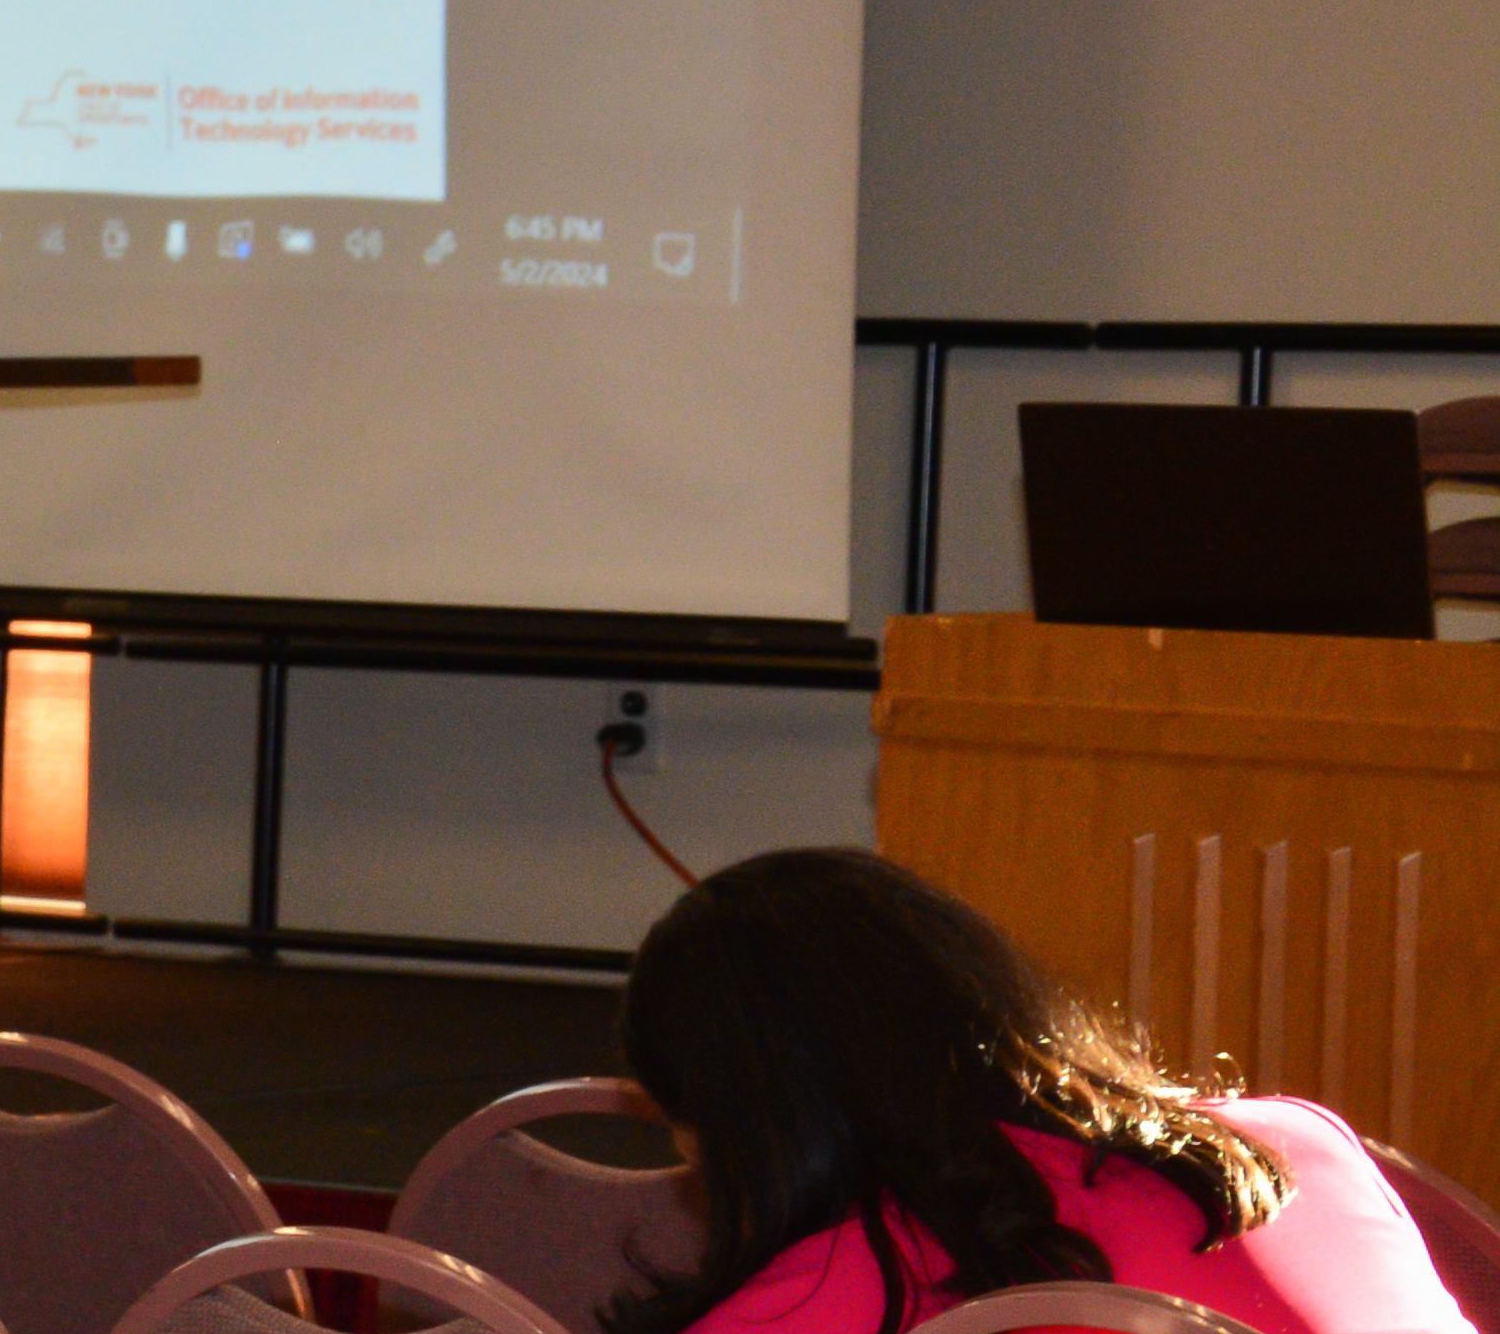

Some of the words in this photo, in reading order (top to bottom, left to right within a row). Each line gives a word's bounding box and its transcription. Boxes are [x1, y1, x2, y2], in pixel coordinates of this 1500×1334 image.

[179, 85, 251, 114] Office
[256, 85, 280, 113] of
[284, 85, 420, 113] Information
[181, 117, 311, 147] Technology
[316, 118, 418, 144] Services
[500, 259, 609, 287] 5/2/2024
